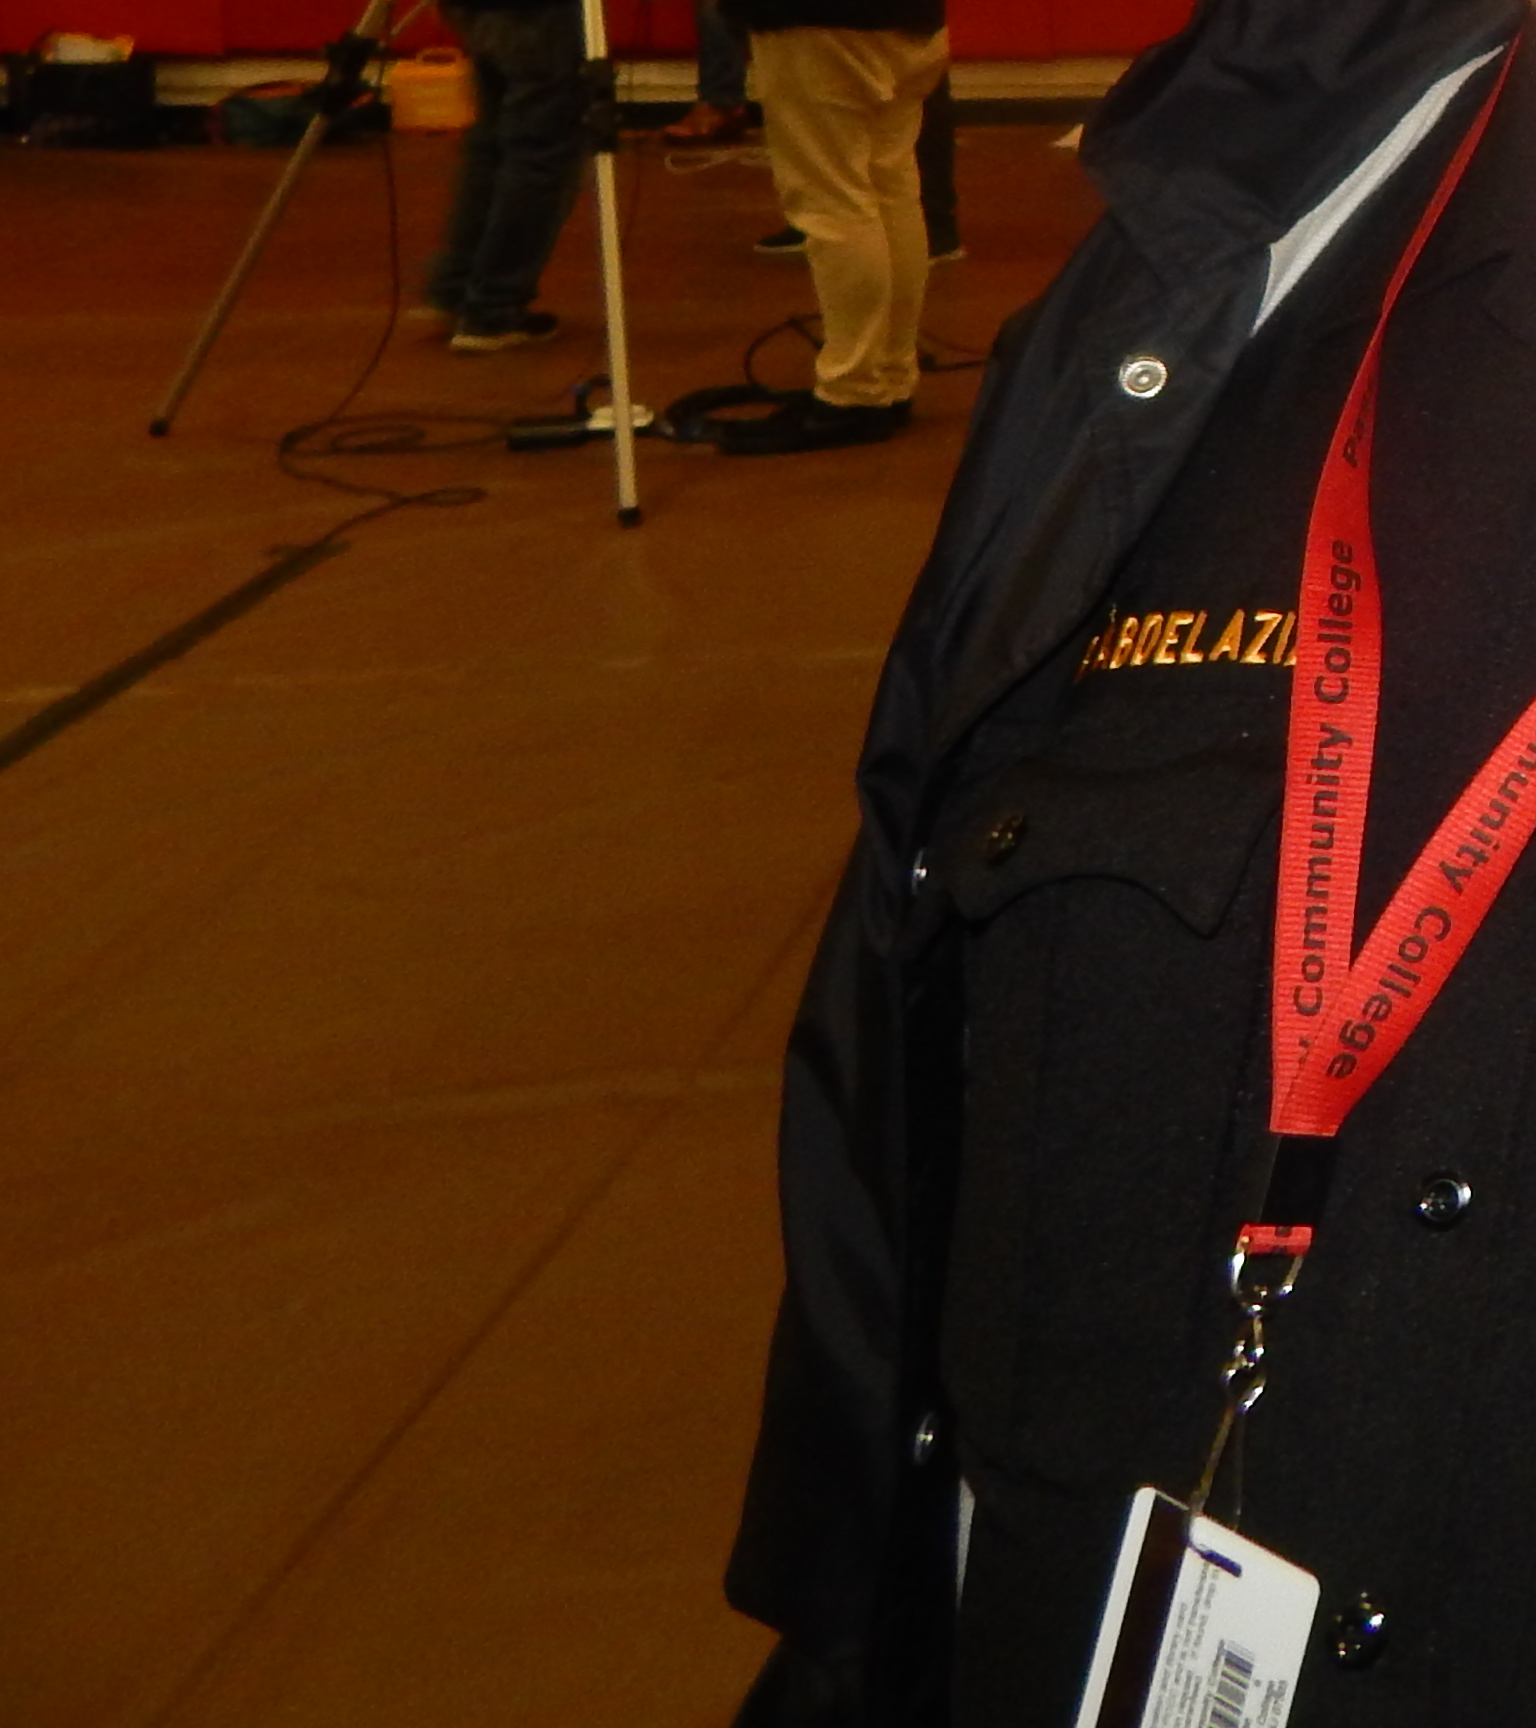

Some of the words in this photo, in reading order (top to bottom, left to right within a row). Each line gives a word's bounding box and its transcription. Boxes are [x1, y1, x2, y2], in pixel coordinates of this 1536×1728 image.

[1314, 539, 1362, 703] College
[1293, 722, 1354, 1018] Community
[1325, 904, 1454, 1080] College
